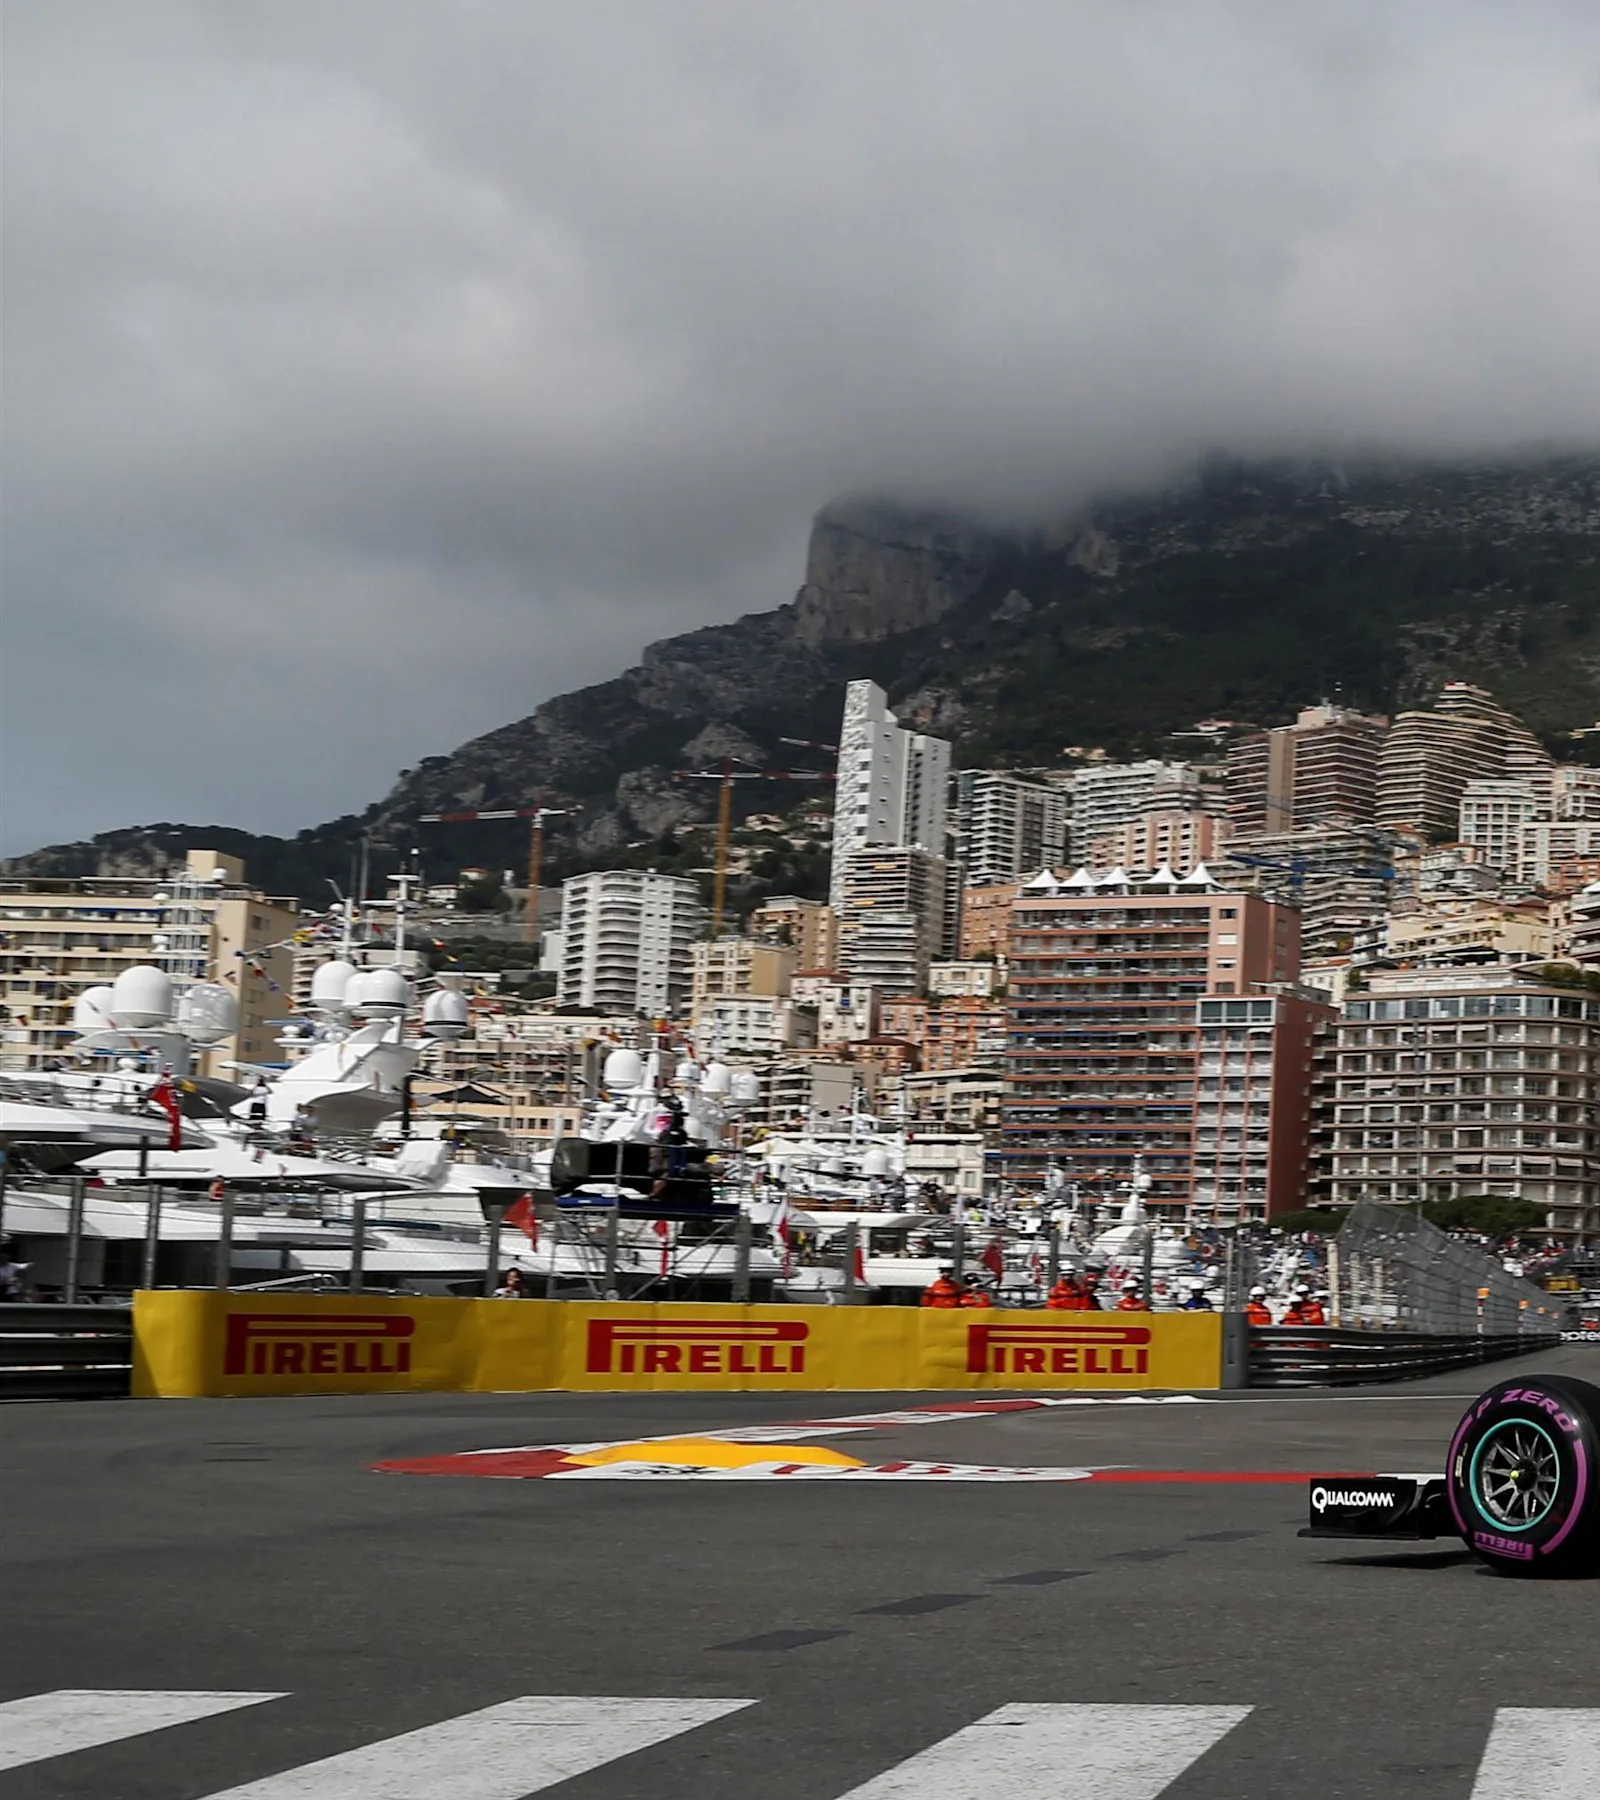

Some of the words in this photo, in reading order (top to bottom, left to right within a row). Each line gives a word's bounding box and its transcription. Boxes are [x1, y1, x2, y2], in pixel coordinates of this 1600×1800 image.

[224, 1313, 415, 1375] PIRELLI
[586, 1318, 810, 1374] PIRELLI
[966, 1323, 1152, 1374] PIRELLI
[1475, 1397, 1493, 1420] P
[1499, 1388, 1577, 1433] ZERO
[1473, 1531, 1535, 1561] PIRELLI
